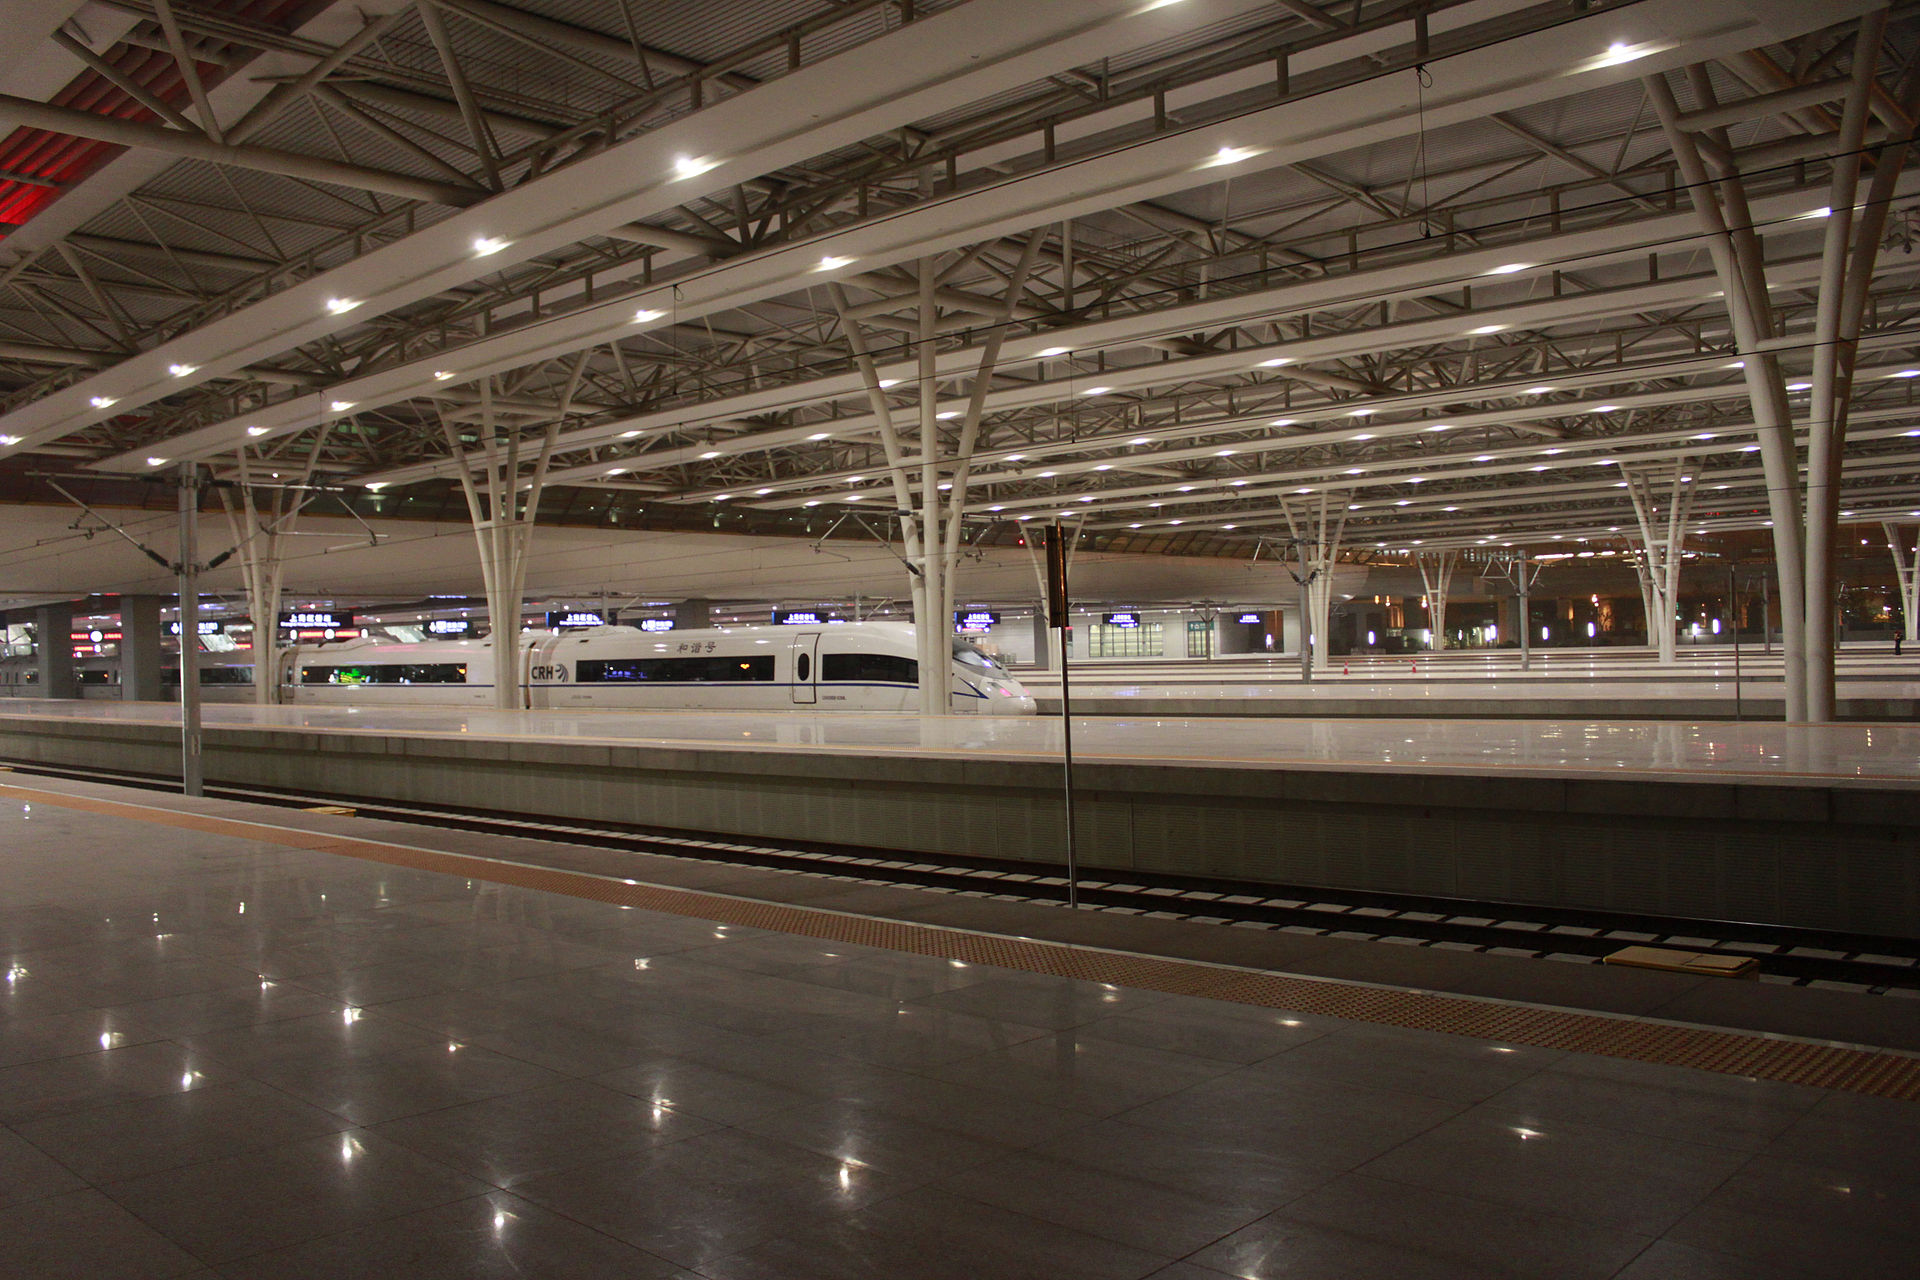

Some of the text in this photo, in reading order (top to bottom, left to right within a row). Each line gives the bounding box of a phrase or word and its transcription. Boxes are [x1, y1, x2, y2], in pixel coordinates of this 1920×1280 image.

[677, 641, 716, 654] 和谐号
[531, 665, 554, 680] CRH
